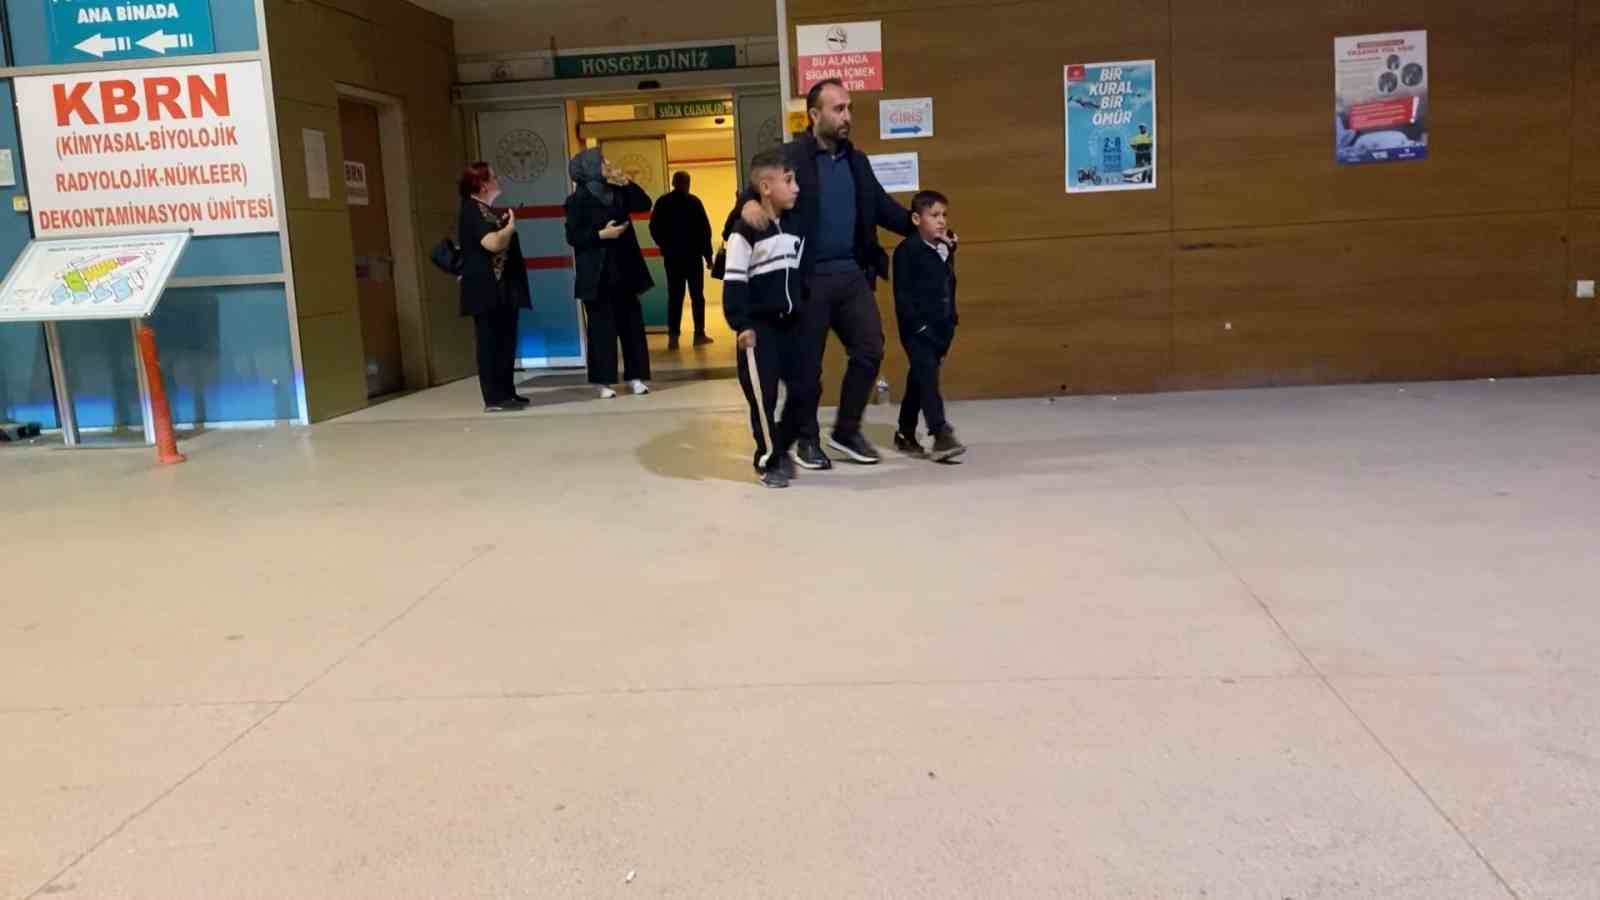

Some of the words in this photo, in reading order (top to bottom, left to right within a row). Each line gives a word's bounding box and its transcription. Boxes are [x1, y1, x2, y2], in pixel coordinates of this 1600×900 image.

[77, 8, 112, 24] ANA
[116, 2, 179, 20] BİNADA
[812, 56, 826, 66] BU
[828, 54, 869, 65] ALANDA
[52, 73, 230, 127] KBRN
[1088, 81, 1132, 96] KURAL
[1092, 109, 1132, 125] ÖMÜR
[56, 124, 238, 160] (KİMYASAL-BİYOLOJİK
[56, 163, 248, 192] RADYOLOJİK-NÜKLEER)
[39, 201, 202, 230] DEKONTAMİNASYON
[206, 192, 274, 223] ÜNİTESİ
